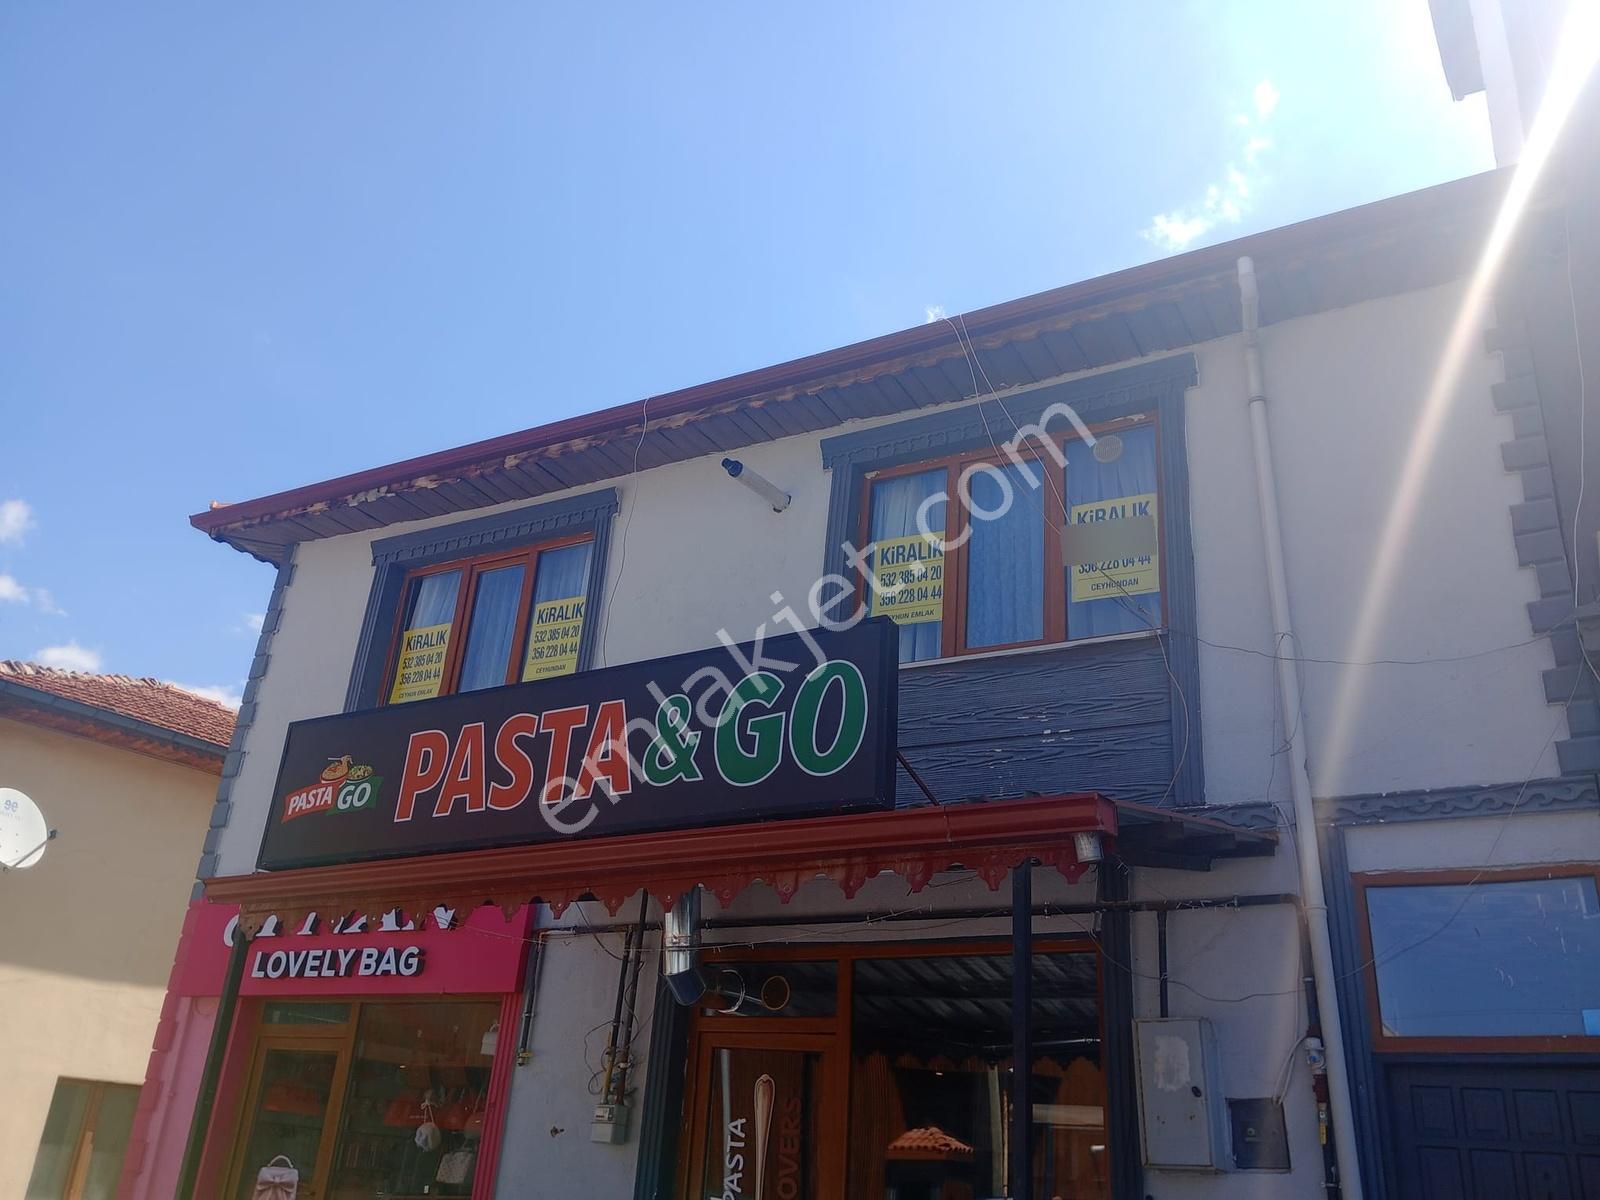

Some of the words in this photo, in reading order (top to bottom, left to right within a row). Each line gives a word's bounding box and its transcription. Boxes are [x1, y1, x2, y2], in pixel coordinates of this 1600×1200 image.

[881, 572, 896, 587] 532
[899, 569, 915, 584] 385
[917, 567, 928, 582] 04
[931, 565, 942, 580] 20
[880, 591, 896, 606] 356
[898, 588, 915, 604] 228
[917, 586, 928, 601] 04
[931, 585, 942, 599] 44
[534, 630, 548, 643] 532
[548, 627, 560, 641] 385
[561, 626, 570, 639] 04
[570, 625, 580, 638] 20
[426, 652, 434, 665] 04
[434, 651, 443, 664] 20
[532, 646, 545, 660] 356
[545, 645, 559, 658] 228
[560, 643, 568, 656] 04
[569, 642, 577, 654] 44
[424, 668, 432, 681] 04
[432, 667, 440, 679] 44
[287, 786, 333, 816] PASTA
[337, 782, 372, 810] GO
[251, 949, 356, 979] LOVELY
[358, 946, 420, 976] BAG
